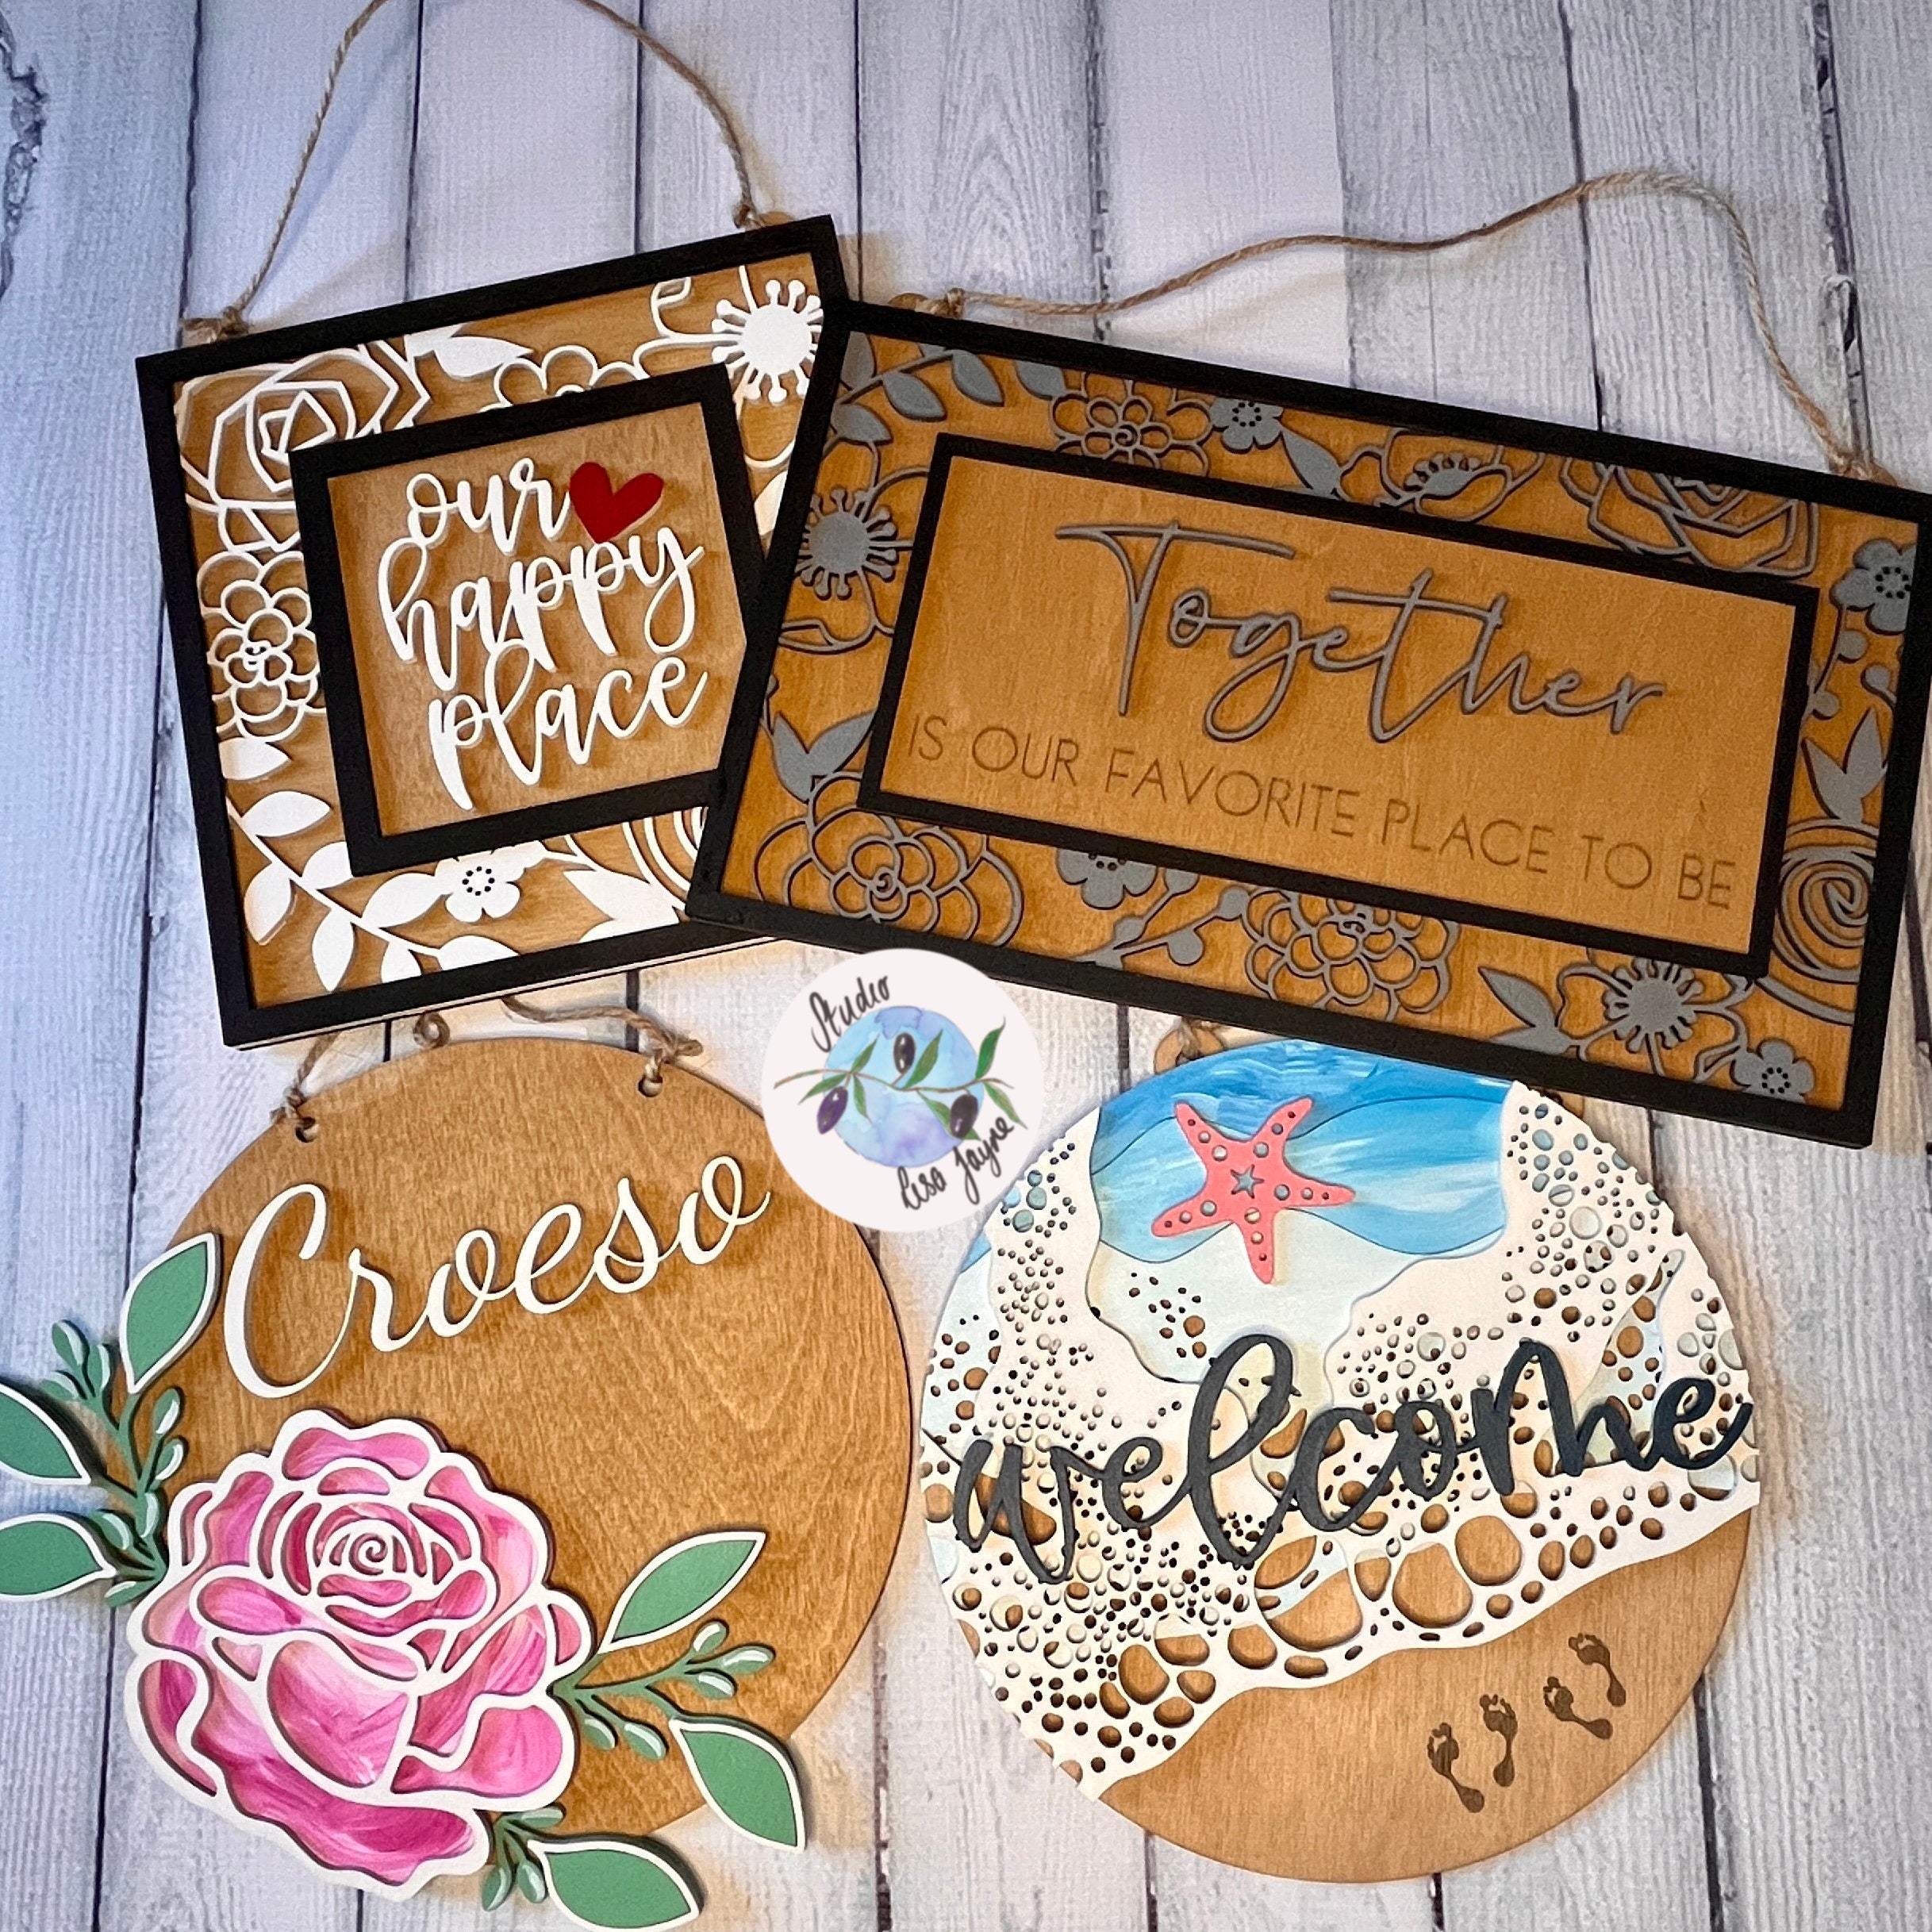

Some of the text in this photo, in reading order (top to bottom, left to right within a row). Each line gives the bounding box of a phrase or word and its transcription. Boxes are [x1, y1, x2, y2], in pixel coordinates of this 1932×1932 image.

[406, 458, 570, 555] our
[377, 528, 705, 692] happy
[1055, 520, 1663, 743] Together
[428, 640, 708, 811] place
[908, 715, 1737, 910] IS OUR FAVORITE PLACE TO BE
[223, 1155, 771, 1398] Croeso
[952, 1332, 1753, 1585] welcome
